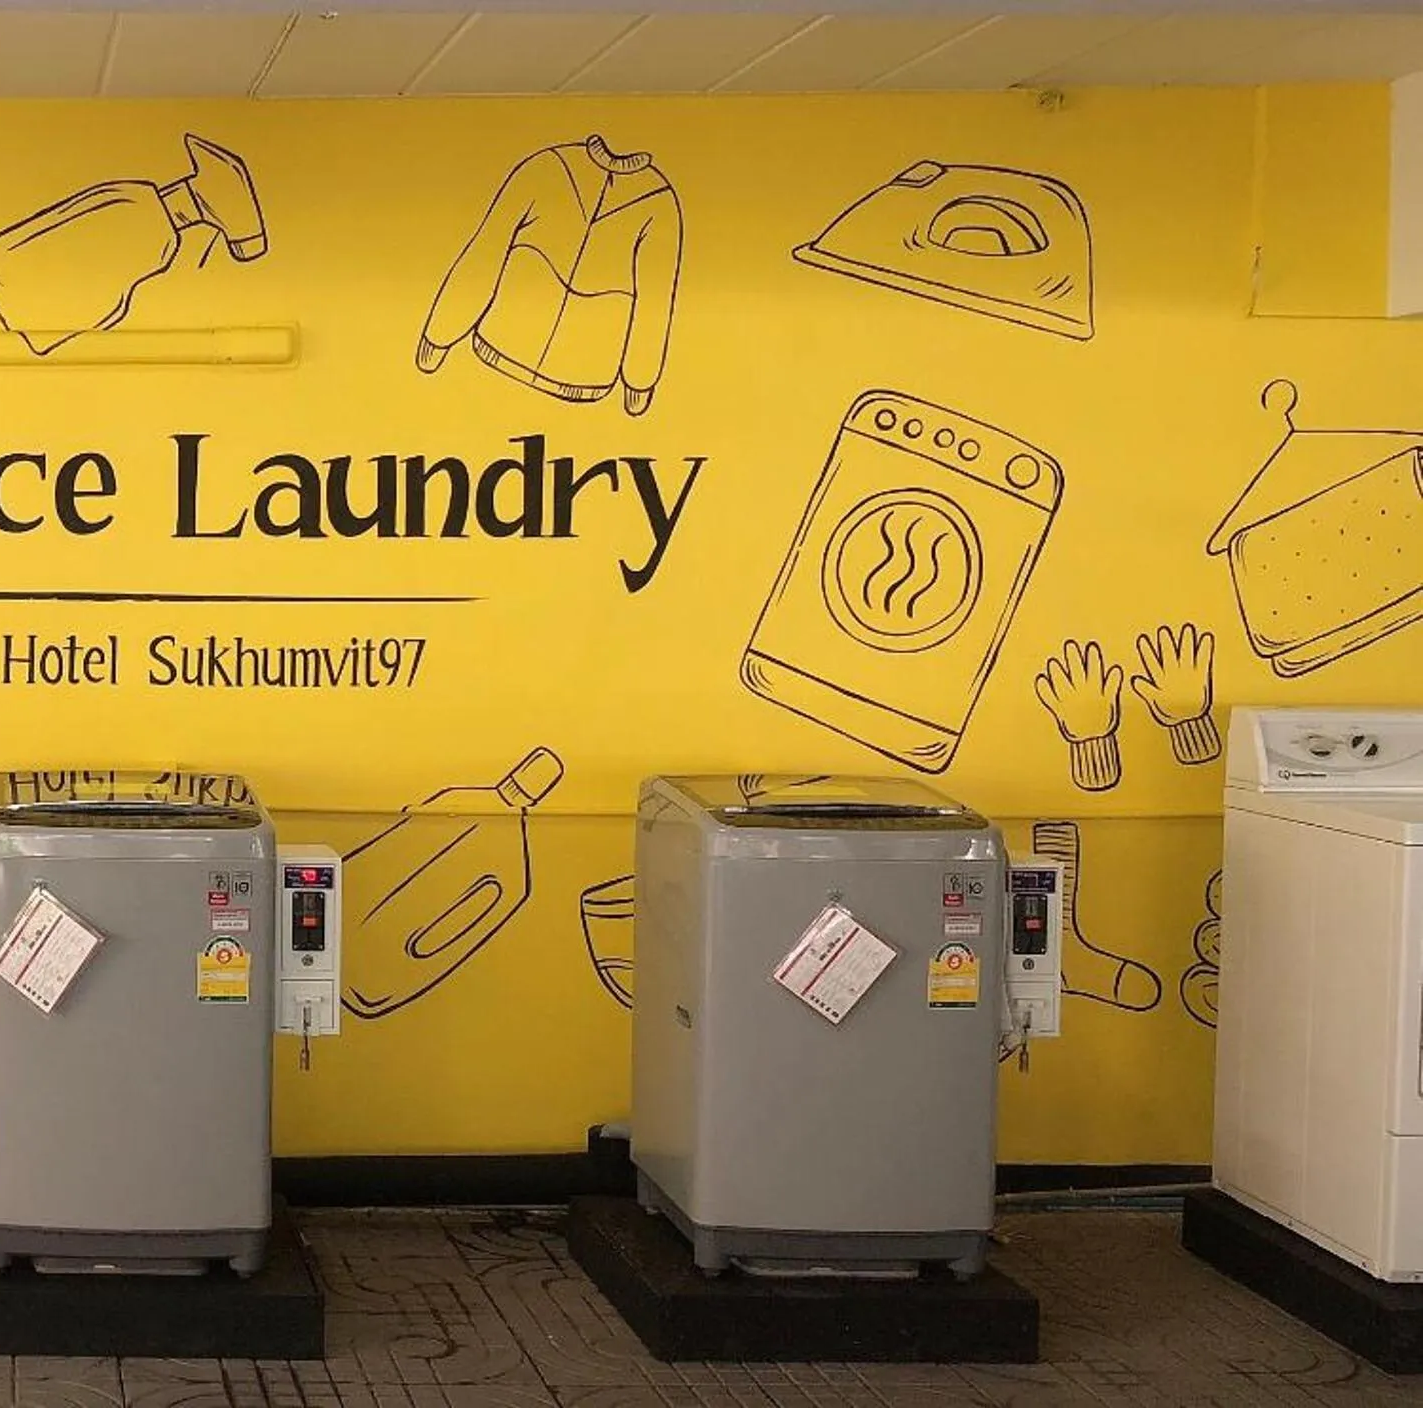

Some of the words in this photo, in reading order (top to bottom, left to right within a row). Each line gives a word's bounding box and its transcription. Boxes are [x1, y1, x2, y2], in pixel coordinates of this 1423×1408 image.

[170, 434, 708, 593] Laundry
[4, 635, 117, 685] Hotel
[150, 635, 426, 687] Sukhumvit97
